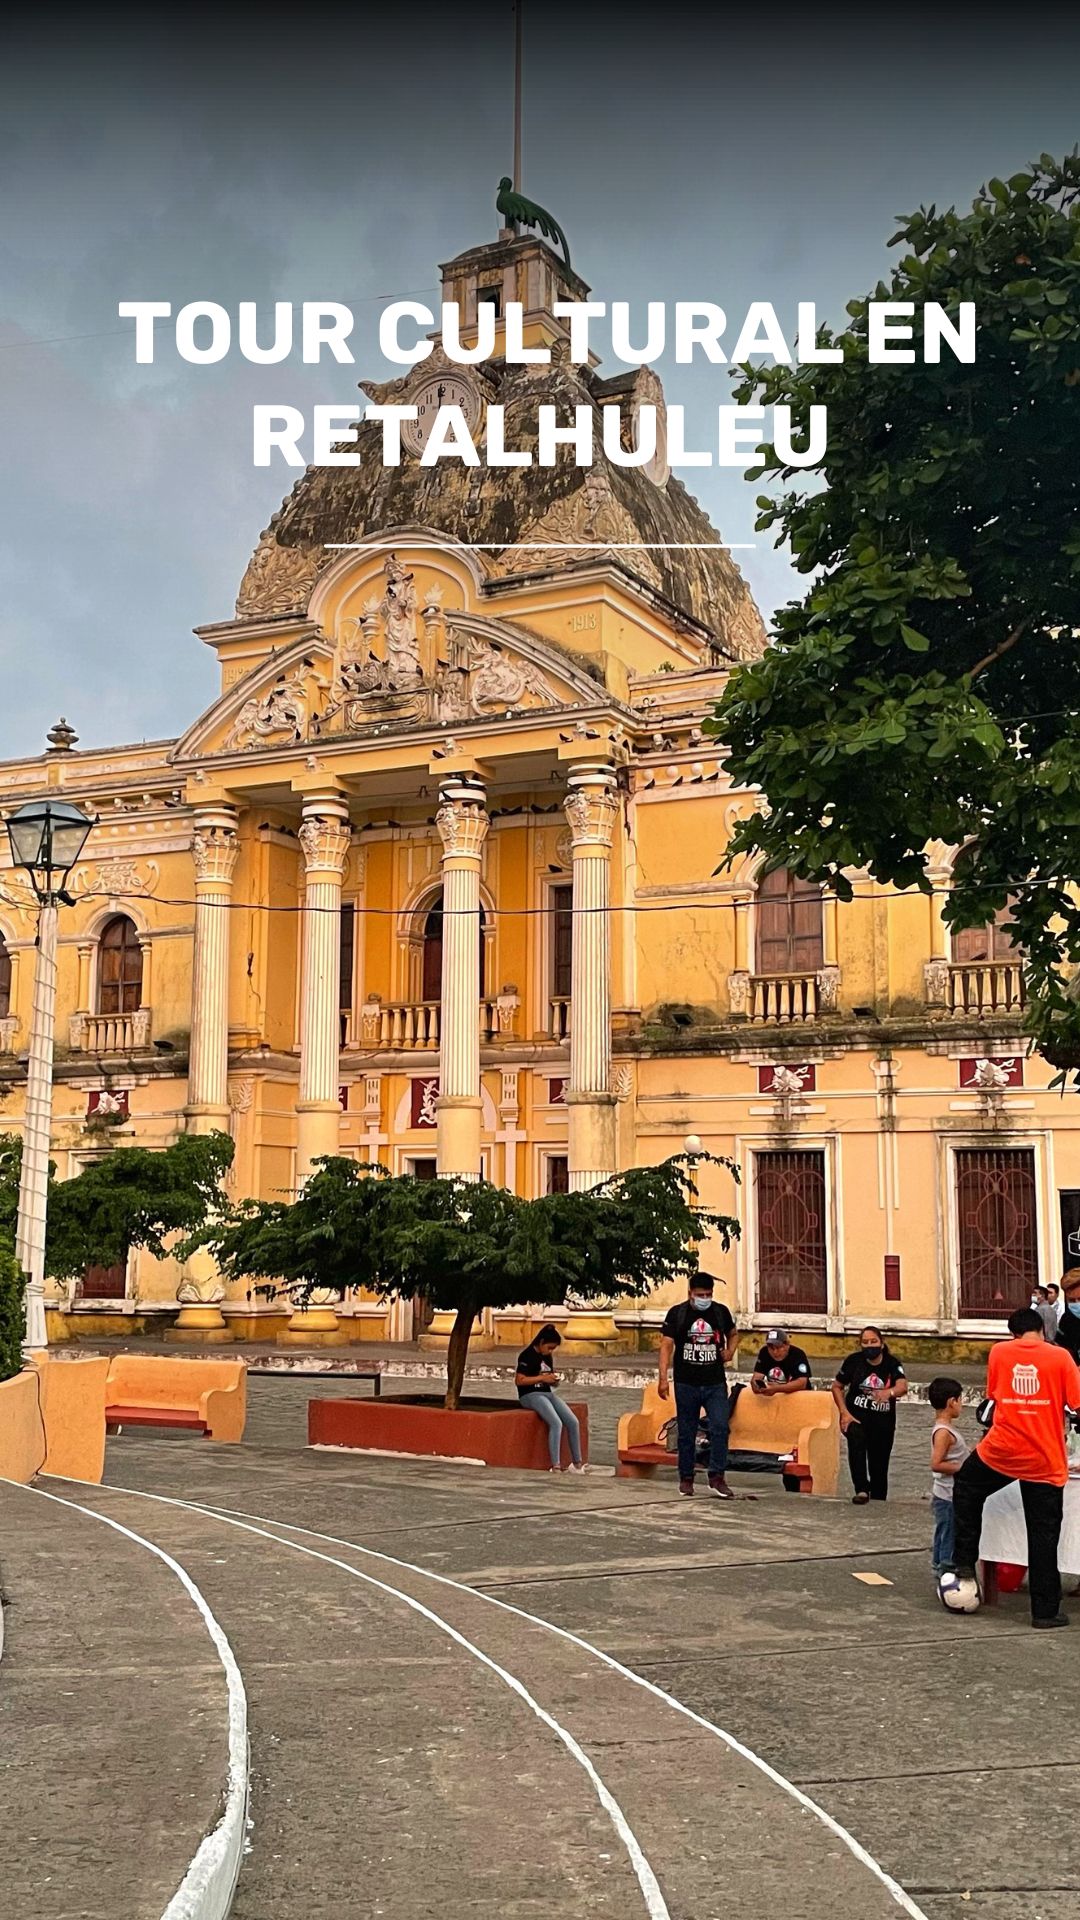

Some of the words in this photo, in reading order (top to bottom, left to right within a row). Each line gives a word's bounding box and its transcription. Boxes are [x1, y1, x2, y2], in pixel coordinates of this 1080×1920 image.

[426, 394, 433, 404] 11
[459, 397, 465, 407] 2
[417, 405, 426, 416] 10
[573, 613, 596, 633] 1913
[683, 1349, 698, 1361] DEL
[853, 1395, 868, 1409] DEL
